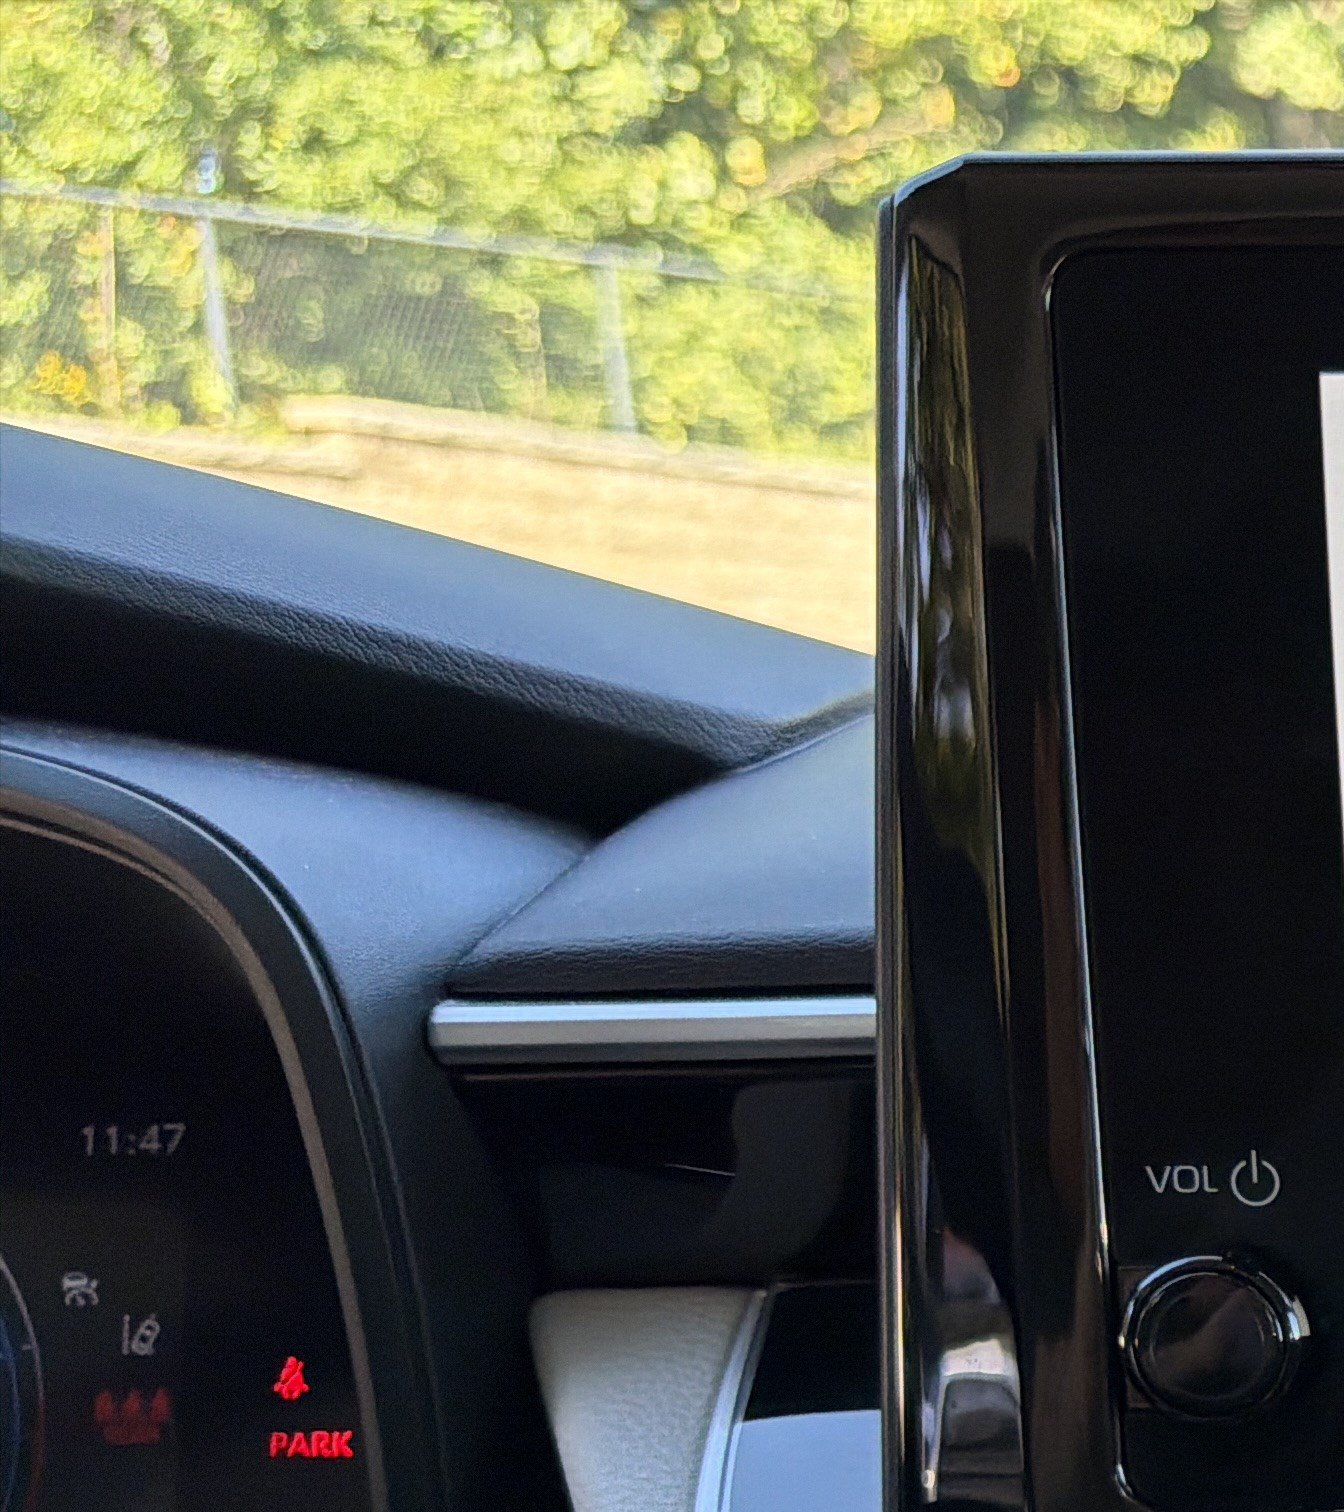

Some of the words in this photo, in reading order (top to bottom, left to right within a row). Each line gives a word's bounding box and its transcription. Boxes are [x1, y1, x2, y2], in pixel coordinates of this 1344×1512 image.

[81, 1122, 187, 1156] 11:47
[1145, 1165, 1219, 1193] VOL
[269, 1429, 354, 1459] PARK
